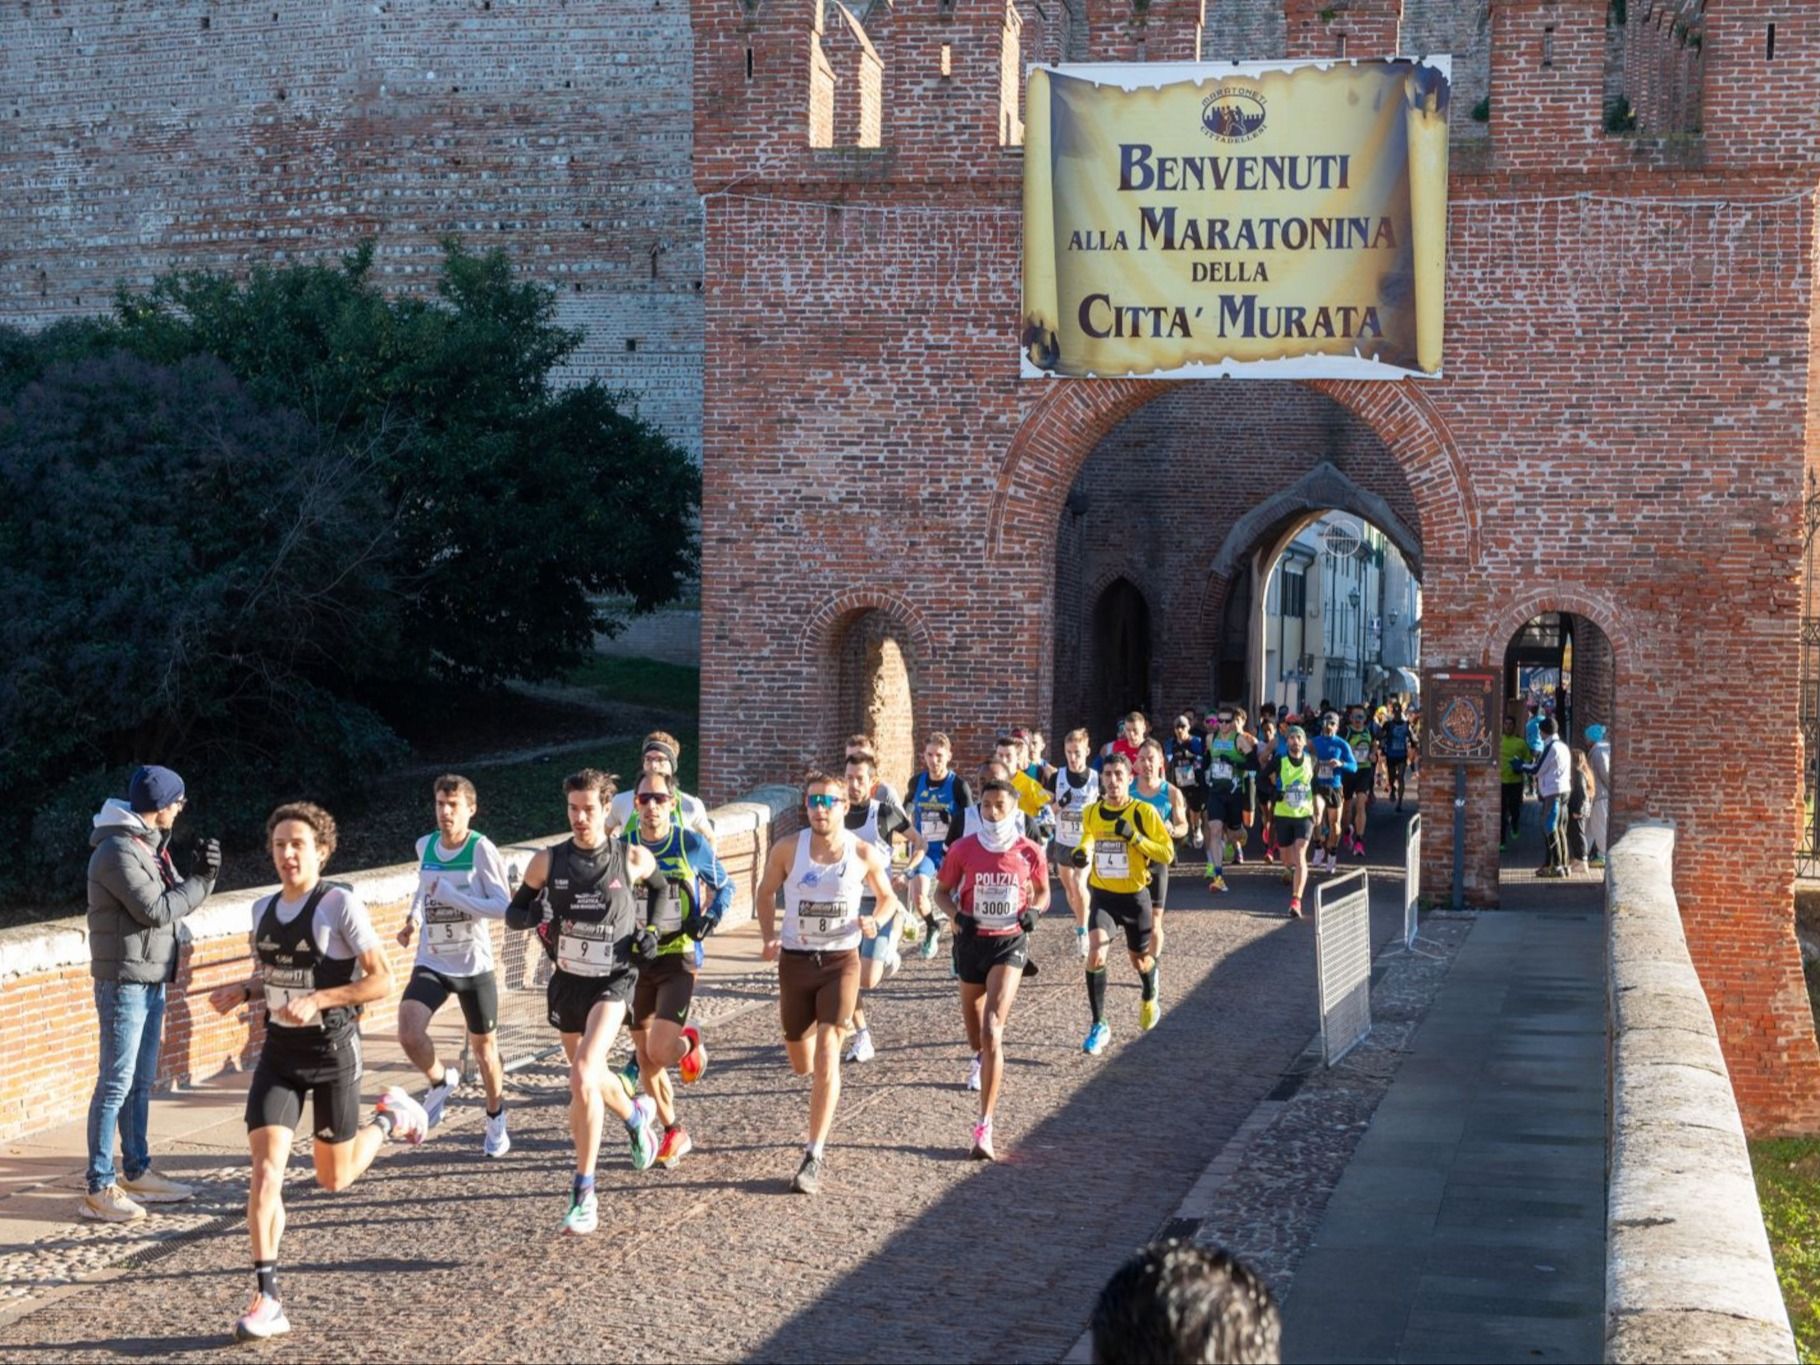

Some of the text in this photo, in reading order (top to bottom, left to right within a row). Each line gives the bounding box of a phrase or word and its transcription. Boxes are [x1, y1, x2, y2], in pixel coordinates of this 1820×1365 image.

[1201, 87, 1268, 106] MARATONETI
[1200, 124, 1268, 144] CITTADELLESI
[1117, 143, 1350, 192] BENVENUTI
[1068, 206, 1397, 251] ALLA MARATONINA
[1191, 261, 1269, 283] DELLA
[1078, 293, 1384, 339] CITTA' MURATA
[975, 872, 1019, 886] POLIZIA
[982, 901, 1011, 916] 3000
[445, 923, 453, 938] 5
[819, 918, 827, 932] 8
[581, 941, 589, 957] 9
